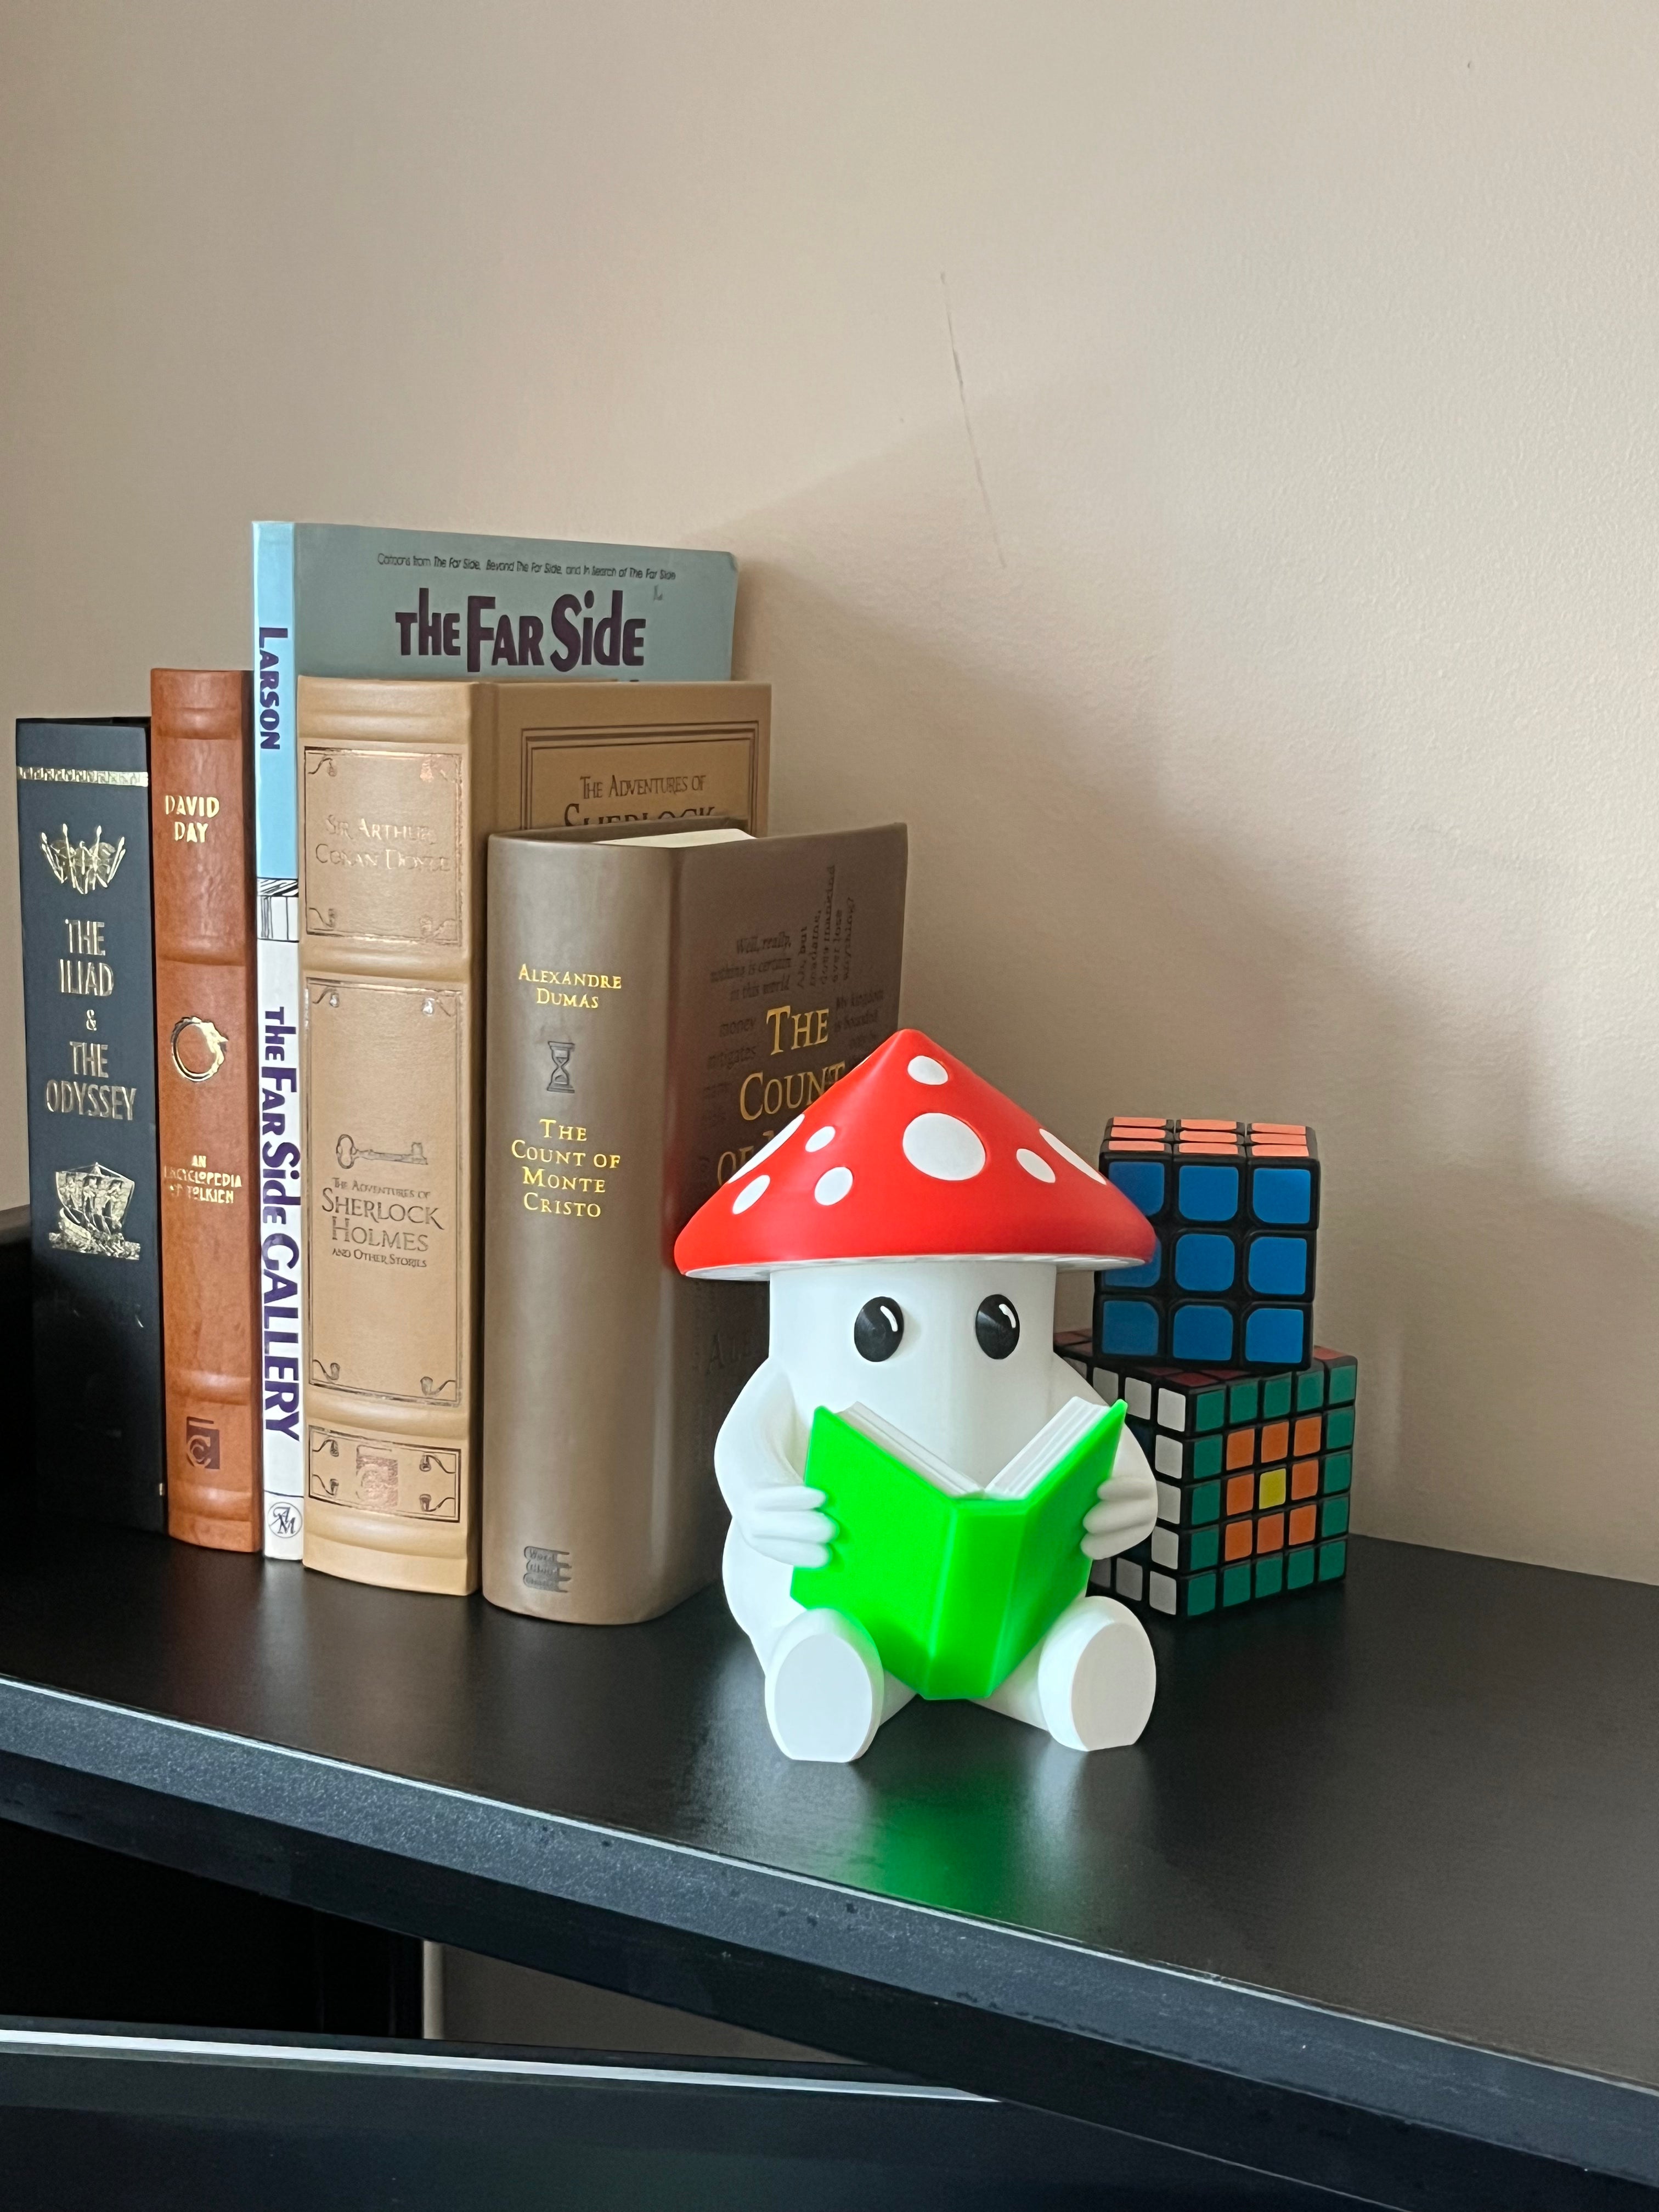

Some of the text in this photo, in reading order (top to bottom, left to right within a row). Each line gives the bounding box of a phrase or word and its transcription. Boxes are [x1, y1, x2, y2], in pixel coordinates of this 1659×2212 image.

[434, 556, 446, 568] The
[449, 557, 461, 568] Far
[486, 560, 515, 572] Beyond
[517, 561, 528, 572] The
[531, 562, 543, 573] Far
[566, 565, 581, 575] and
[591, 566, 616, 577] Search
[619, 567, 629, 578] of
[630, 567, 643, 578] The
[646, 568, 657, 579] Far
[660, 569, 676, 580] Side
[467, 595, 544, 673] FAR
[259, 627, 289, 750] LARSON
[580, 775, 707, 799] THE ADVENTURES OF
[165, 794, 220, 819] DAVID
[174, 821, 208, 844] DAY
[65, 918, 105, 956] THE
[60, 958, 114, 997] ILIAD
[518, 963, 622, 989] ALEXANDRE
[536, 988, 599, 1009] DUMAS
[85, 1009, 97, 1031] &
[766, 1005, 830, 1056] THE
[69, 1041, 109, 1079] THE
[46, 1080, 137, 1121] ODYSSEY
[261, 1066, 297, 1136] FAR
[740, 1060, 846, 1121] COUNT
[540, 1119, 587, 1142] THE
[191, 1155, 206, 1168] AN
[511, 1139, 621, 1169] COUNT OF
[331, 1177, 431, 1199] THE ADVENTURES OF
[522, 1166, 606, 1193] MONTE
[187, 1185, 234, 1204] TOLKIEN
[523, 1193, 602, 1218] CRISTO
[321, 1187, 445, 1230] SHERLOCK
[331, 1216, 429, 1251] HOLMES
[354, 1249, 388, 1265] OTHER
[390, 1254, 427, 1268] STORIES
[262, 1233, 301, 1442] GALLERY
